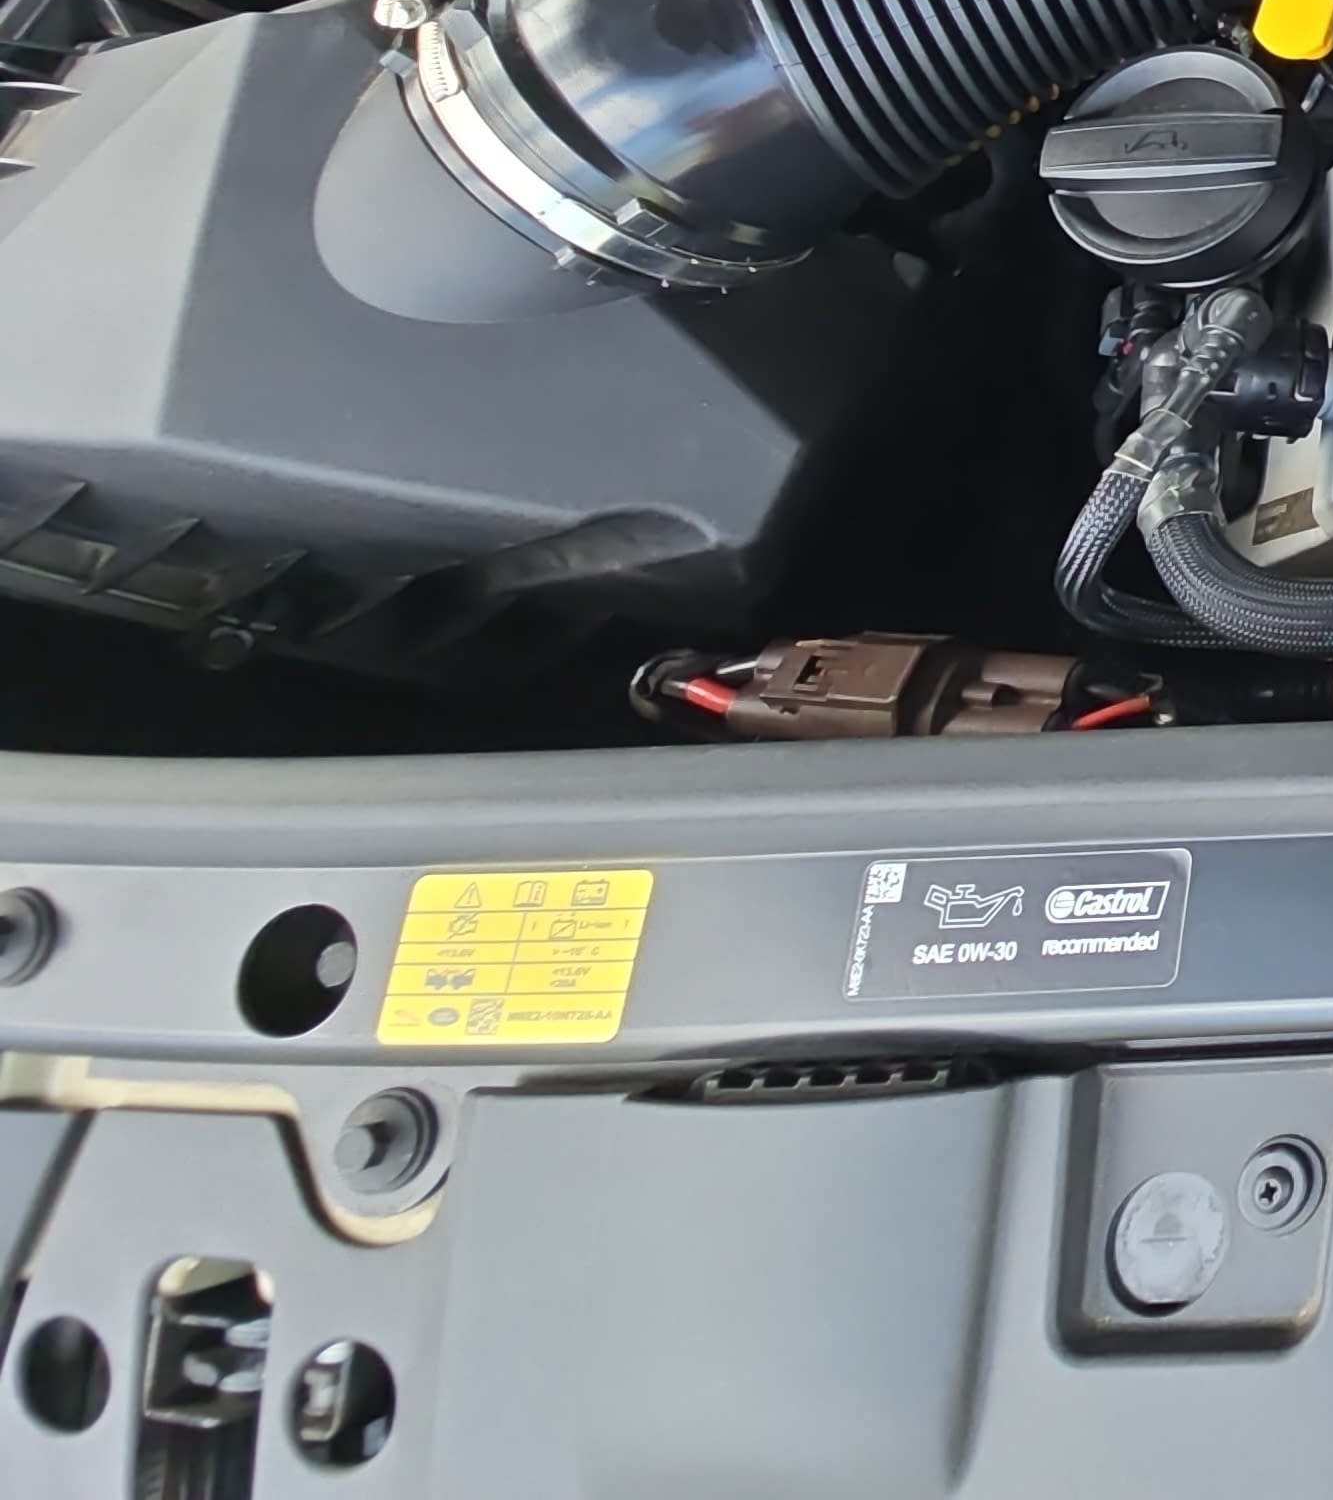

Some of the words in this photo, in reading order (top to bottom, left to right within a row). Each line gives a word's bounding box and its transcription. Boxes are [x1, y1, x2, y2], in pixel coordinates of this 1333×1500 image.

[1074, 885, 1155, 918] Castrol
[912, 943, 955, 965] SAE
[957, 940, 1019, 963] 0W-30
[1042, 931, 1160, 957] recommended
